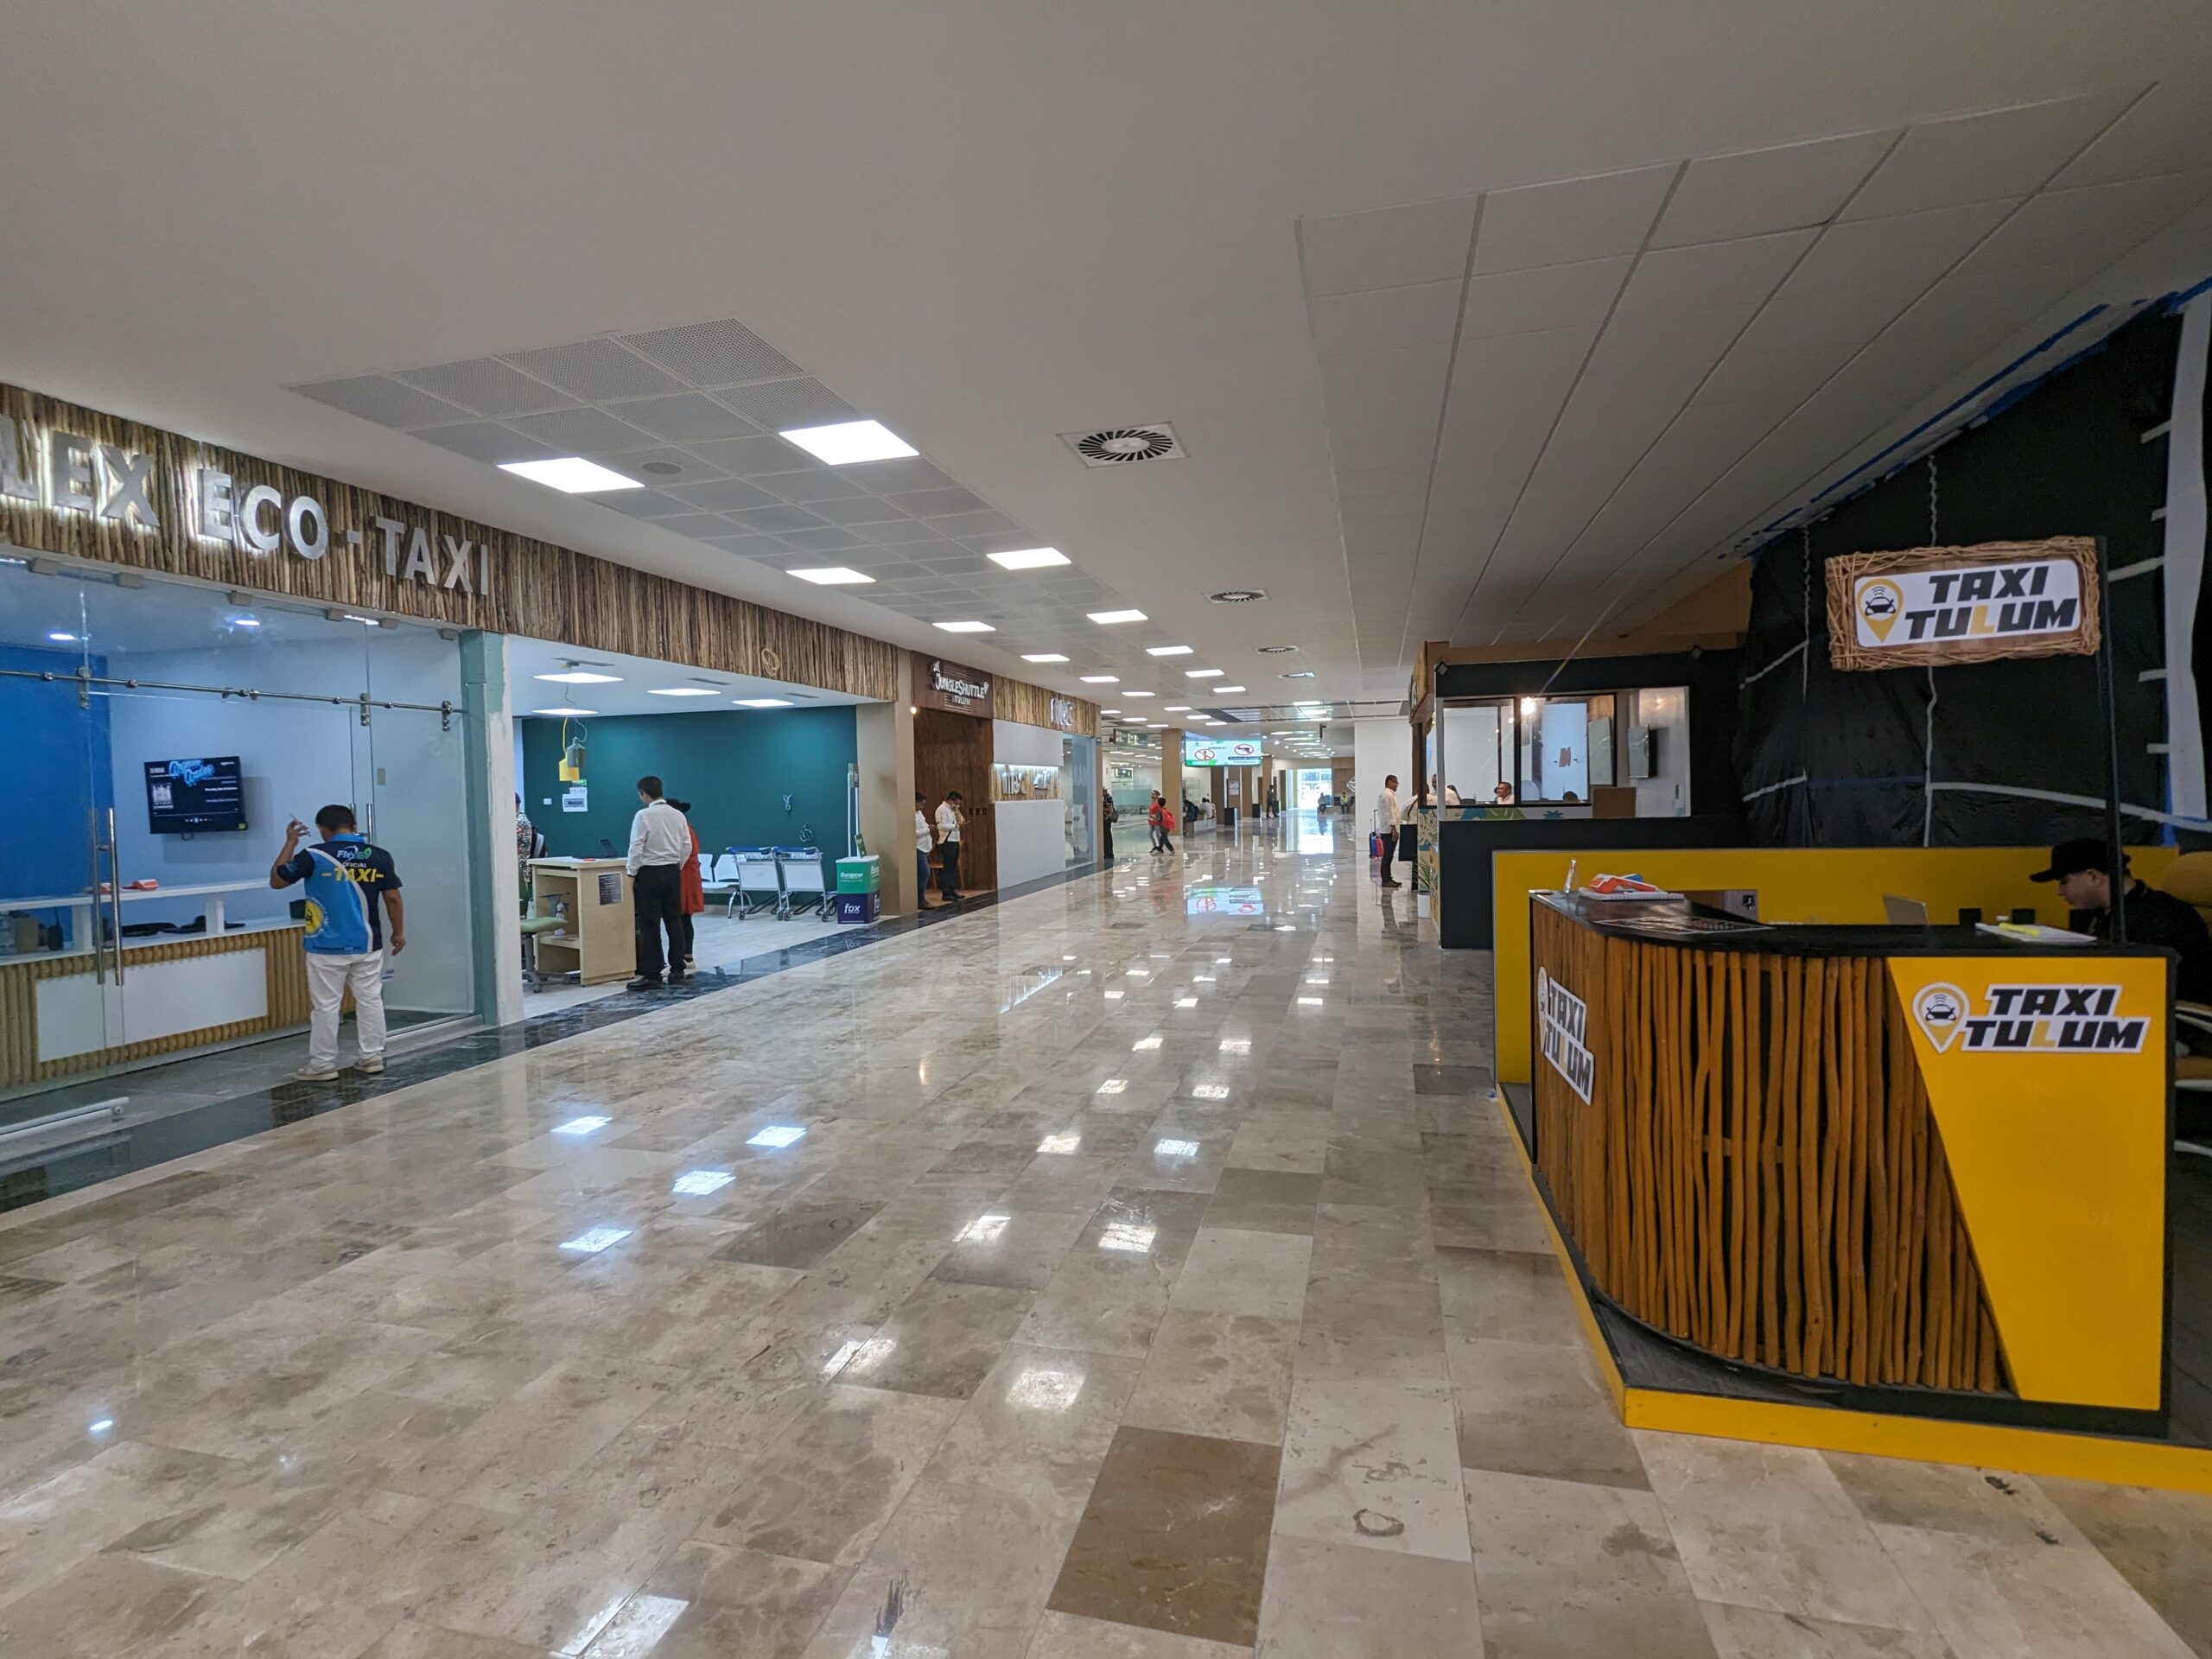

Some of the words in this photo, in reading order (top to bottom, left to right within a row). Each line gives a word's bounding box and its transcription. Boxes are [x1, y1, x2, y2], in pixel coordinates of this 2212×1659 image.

[198, 468, 329, 560] ECO
[376, 516, 488, 595] TAXI
[1929, 566, 2049, 604] TAXI
[1905, 598, 2077, 639] TULUM
[844, 903, 861, 914] fox
[1550, 985, 1585, 1043] TAXI
[1991, 988, 2116, 1016] TAXI
[1964, 1020, 2145, 1049] TULUM
[1546, 1018, 1592, 1097] TULUM
